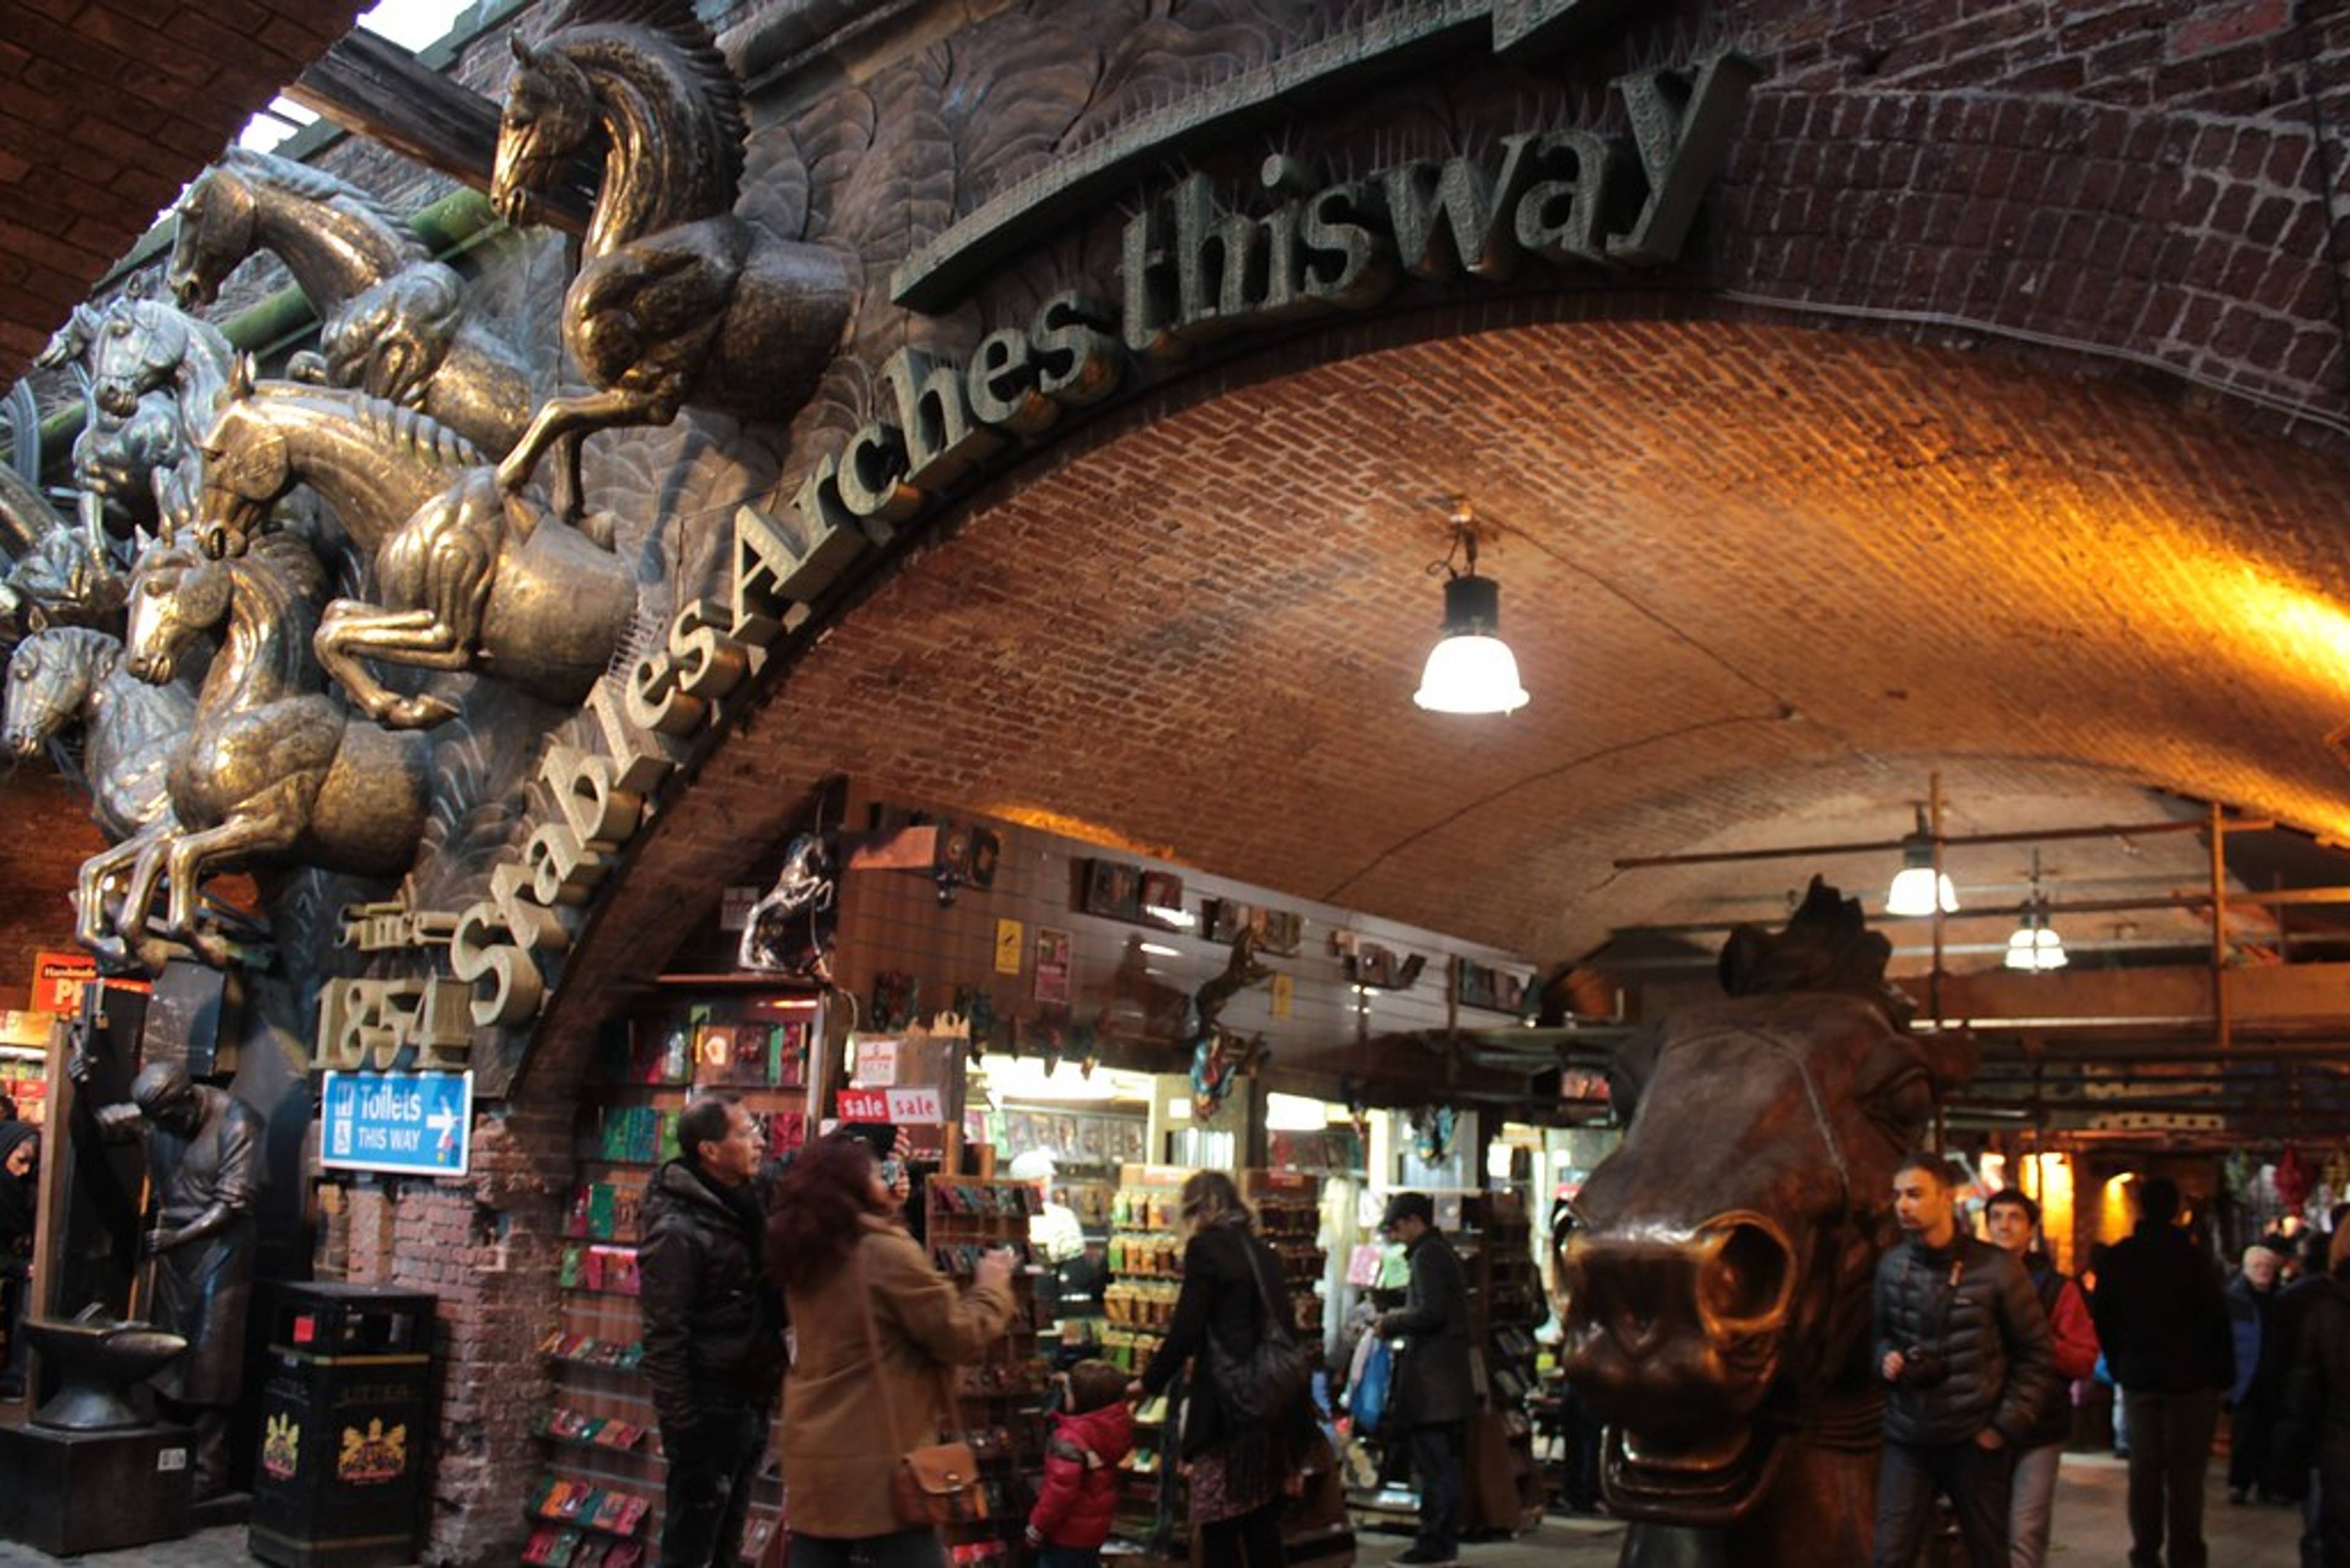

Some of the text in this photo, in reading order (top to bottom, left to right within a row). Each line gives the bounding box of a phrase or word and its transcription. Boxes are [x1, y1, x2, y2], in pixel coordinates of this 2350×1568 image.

[449, 53, 1736, 1028] Stables Arches this way
[310, 972, 469, 1069] 1854
[360, 1082, 421, 1121] Toilets
[845, 1094, 934, 1116] sale sale
[357, 1127, 421, 1151] THIS WAY
